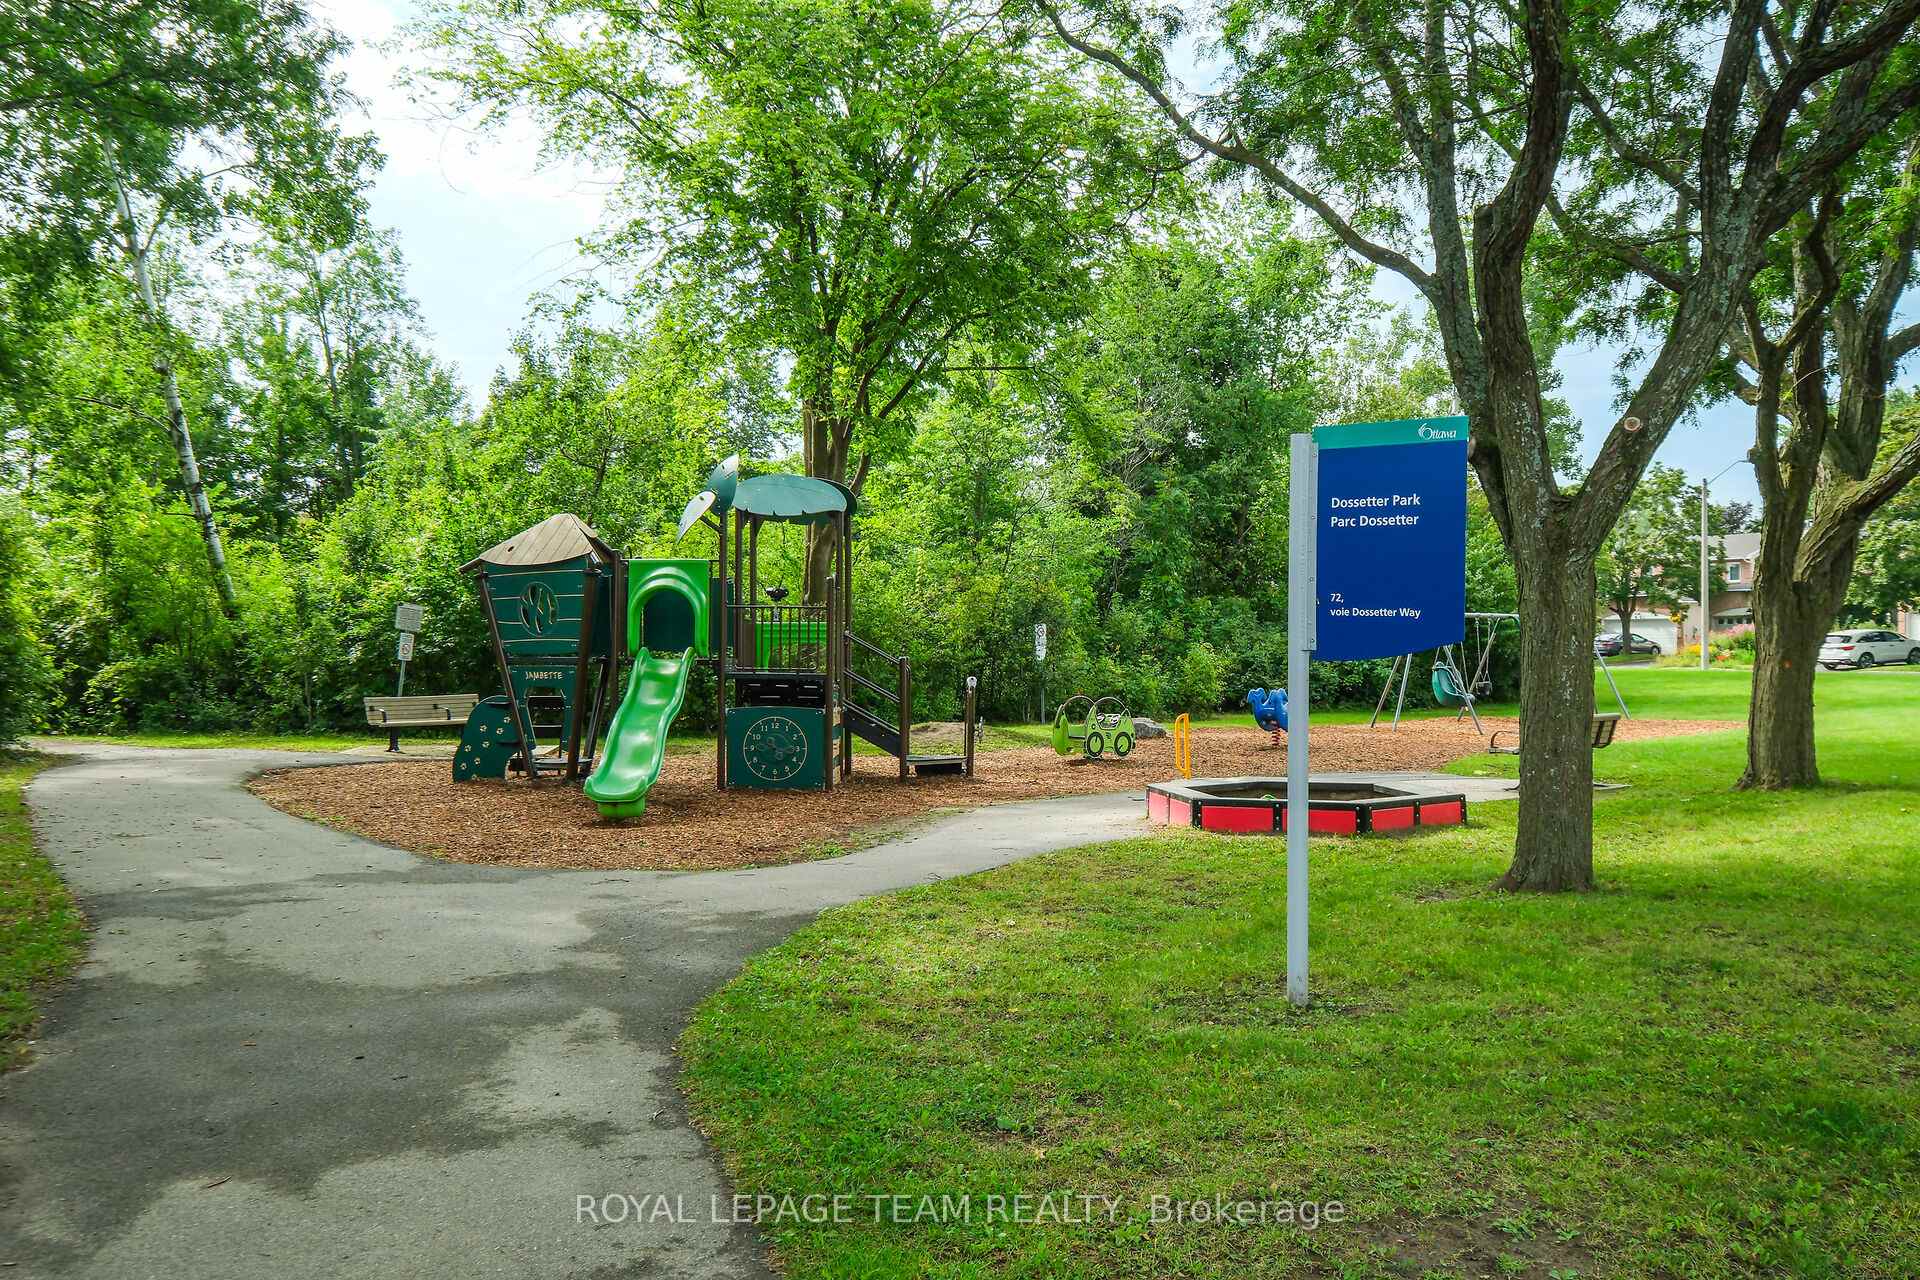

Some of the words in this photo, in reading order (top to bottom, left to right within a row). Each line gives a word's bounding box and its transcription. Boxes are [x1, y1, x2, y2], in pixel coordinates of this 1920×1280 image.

[1418, 422, 1457, 440] Ottawa
[1331, 496, 1390, 509] Dossetter
[1392, 493, 1421, 506] Park
[1330, 516, 1357, 528] Parc
[1359, 514, 1419, 527] Dossetter
[1330, 593, 1344, 604] 72,
[1330, 607, 1350, 616] voie
[1352, 607, 1398, 617] Dossetter
[1399, 607, 1421, 620] Way
[525, 671, 563, 681] JAMBETTE
[752, 733, 761, 741] 10
